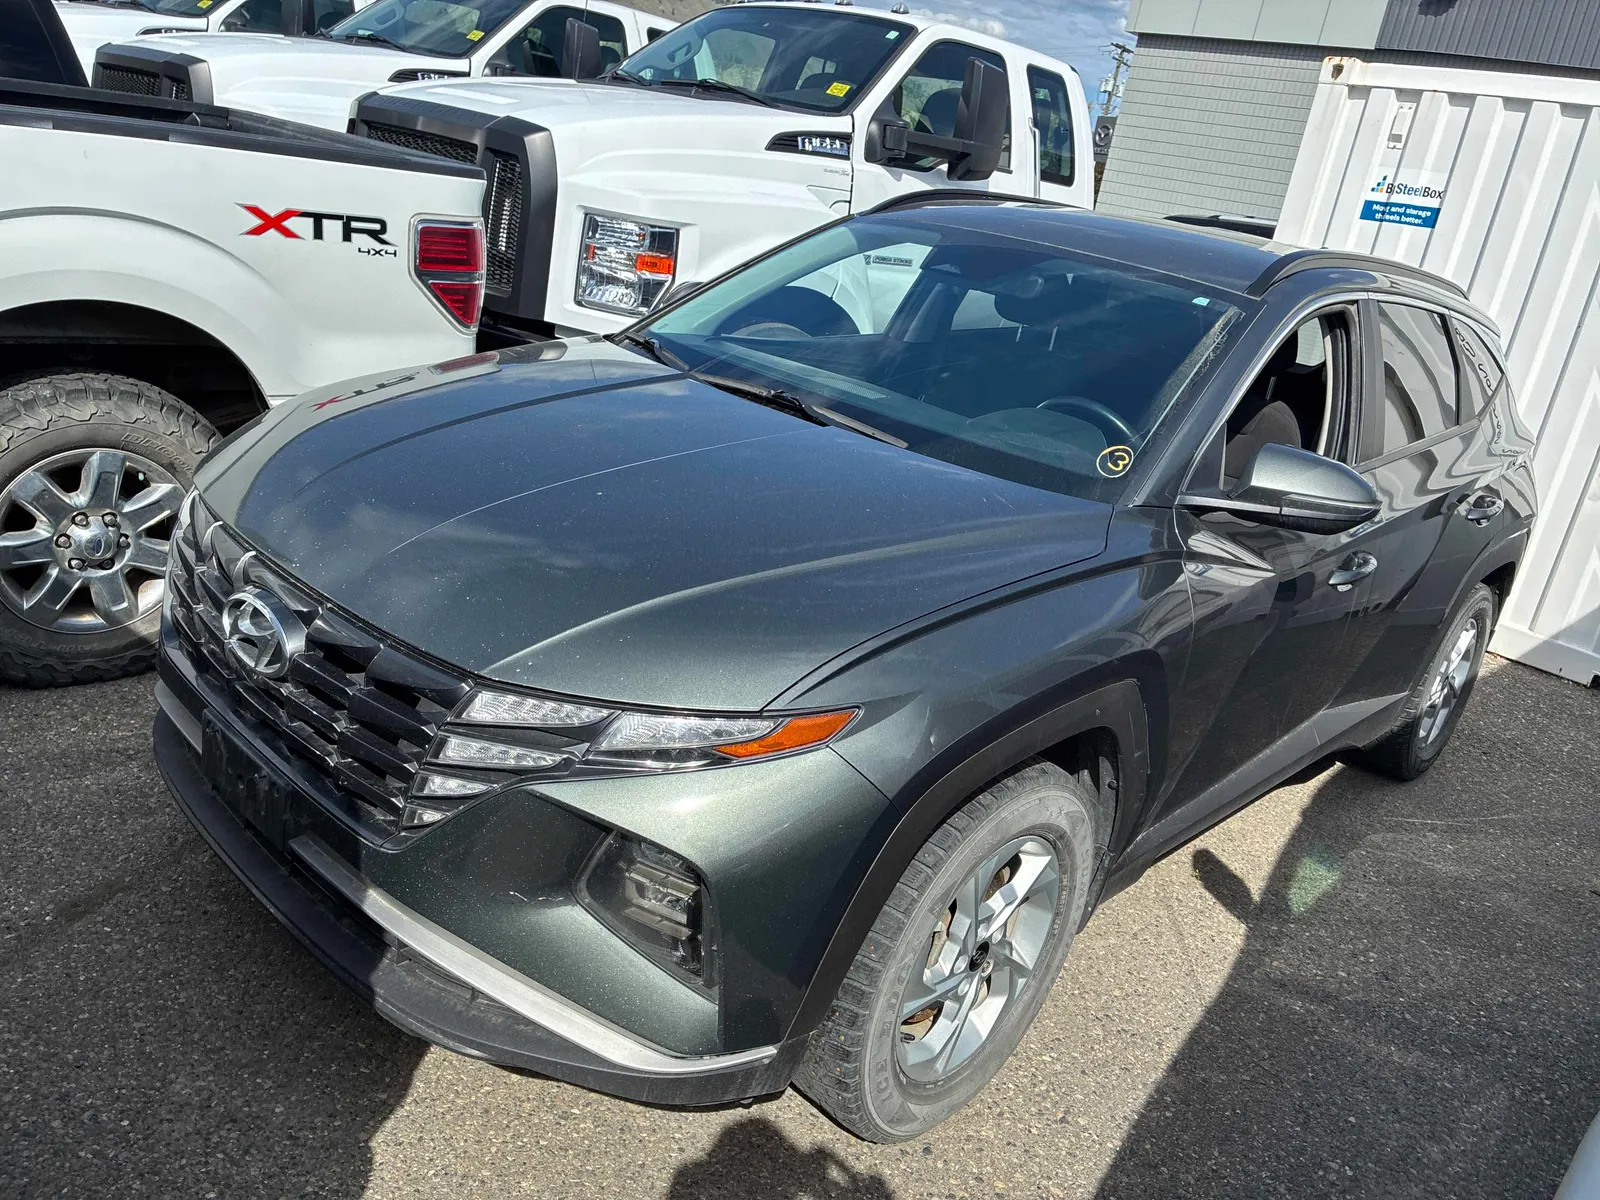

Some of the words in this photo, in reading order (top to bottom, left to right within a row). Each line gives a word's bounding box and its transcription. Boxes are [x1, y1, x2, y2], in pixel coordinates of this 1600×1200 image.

[1385, 182, 1444, 200] BSteelBox
[1400, 214, 1424, 225] better.
[1405, 207, 1432, 218] storage
[234, 202, 399, 247] XTR
[876, 1057, 895, 1103] ICE
